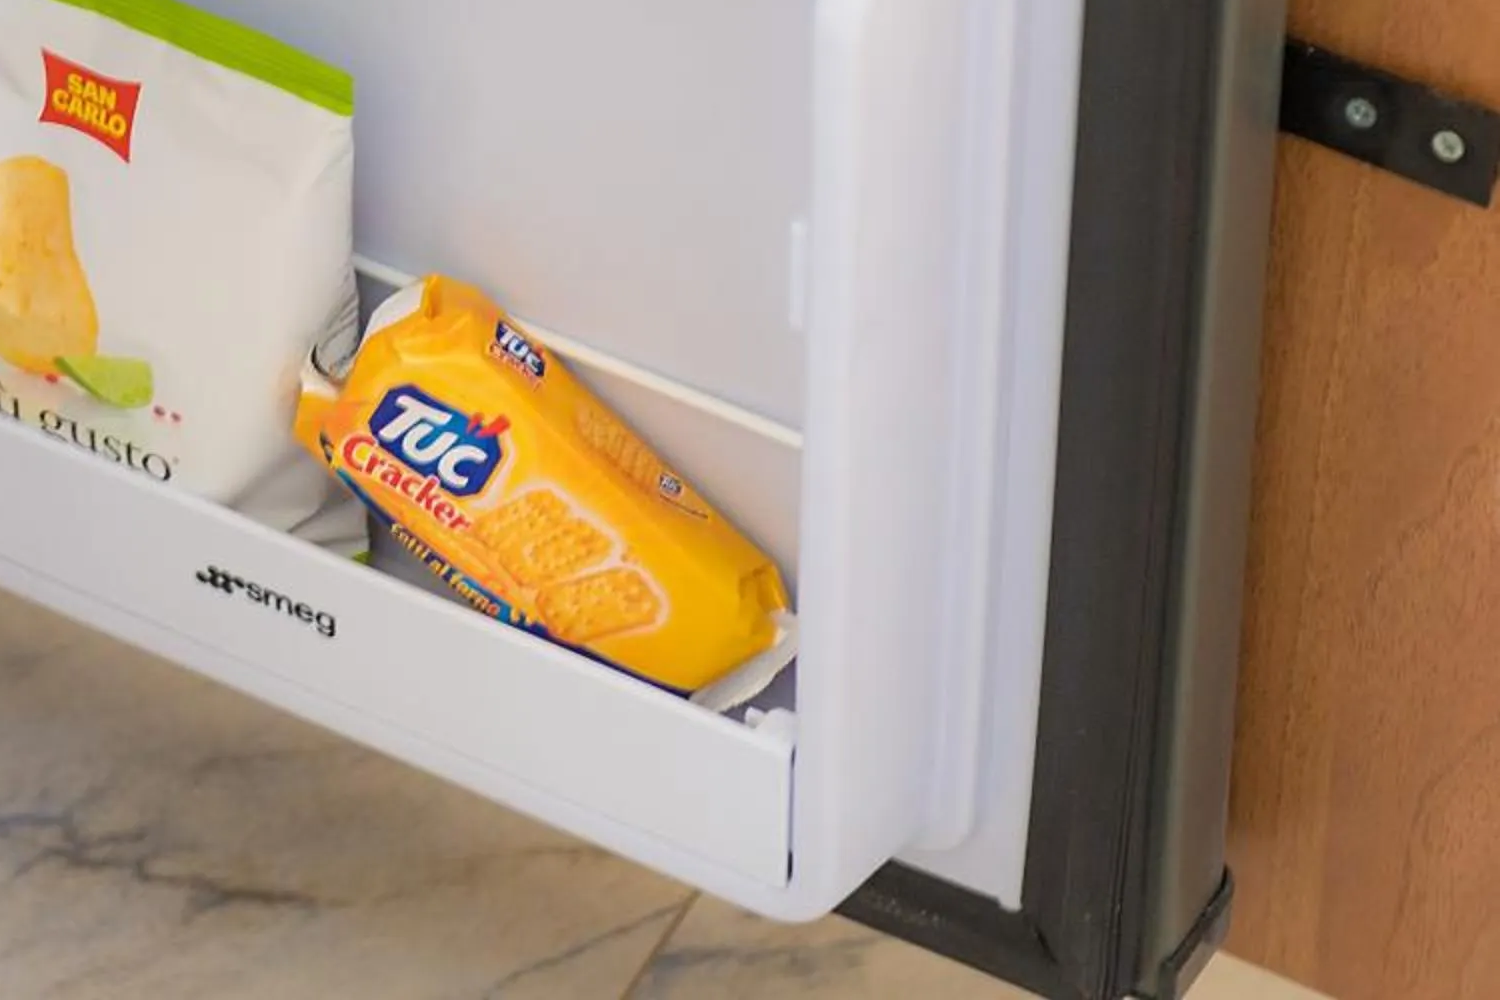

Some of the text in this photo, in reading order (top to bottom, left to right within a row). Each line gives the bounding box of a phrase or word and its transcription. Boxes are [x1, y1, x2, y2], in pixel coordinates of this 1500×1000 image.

[52, 88, 127, 138] CARLO
[67, 73, 117, 111] SAN
[378, 395, 488, 488] TUC
[342, 433, 472, 532] Cracker
[247, 581, 336, 638] smeg
